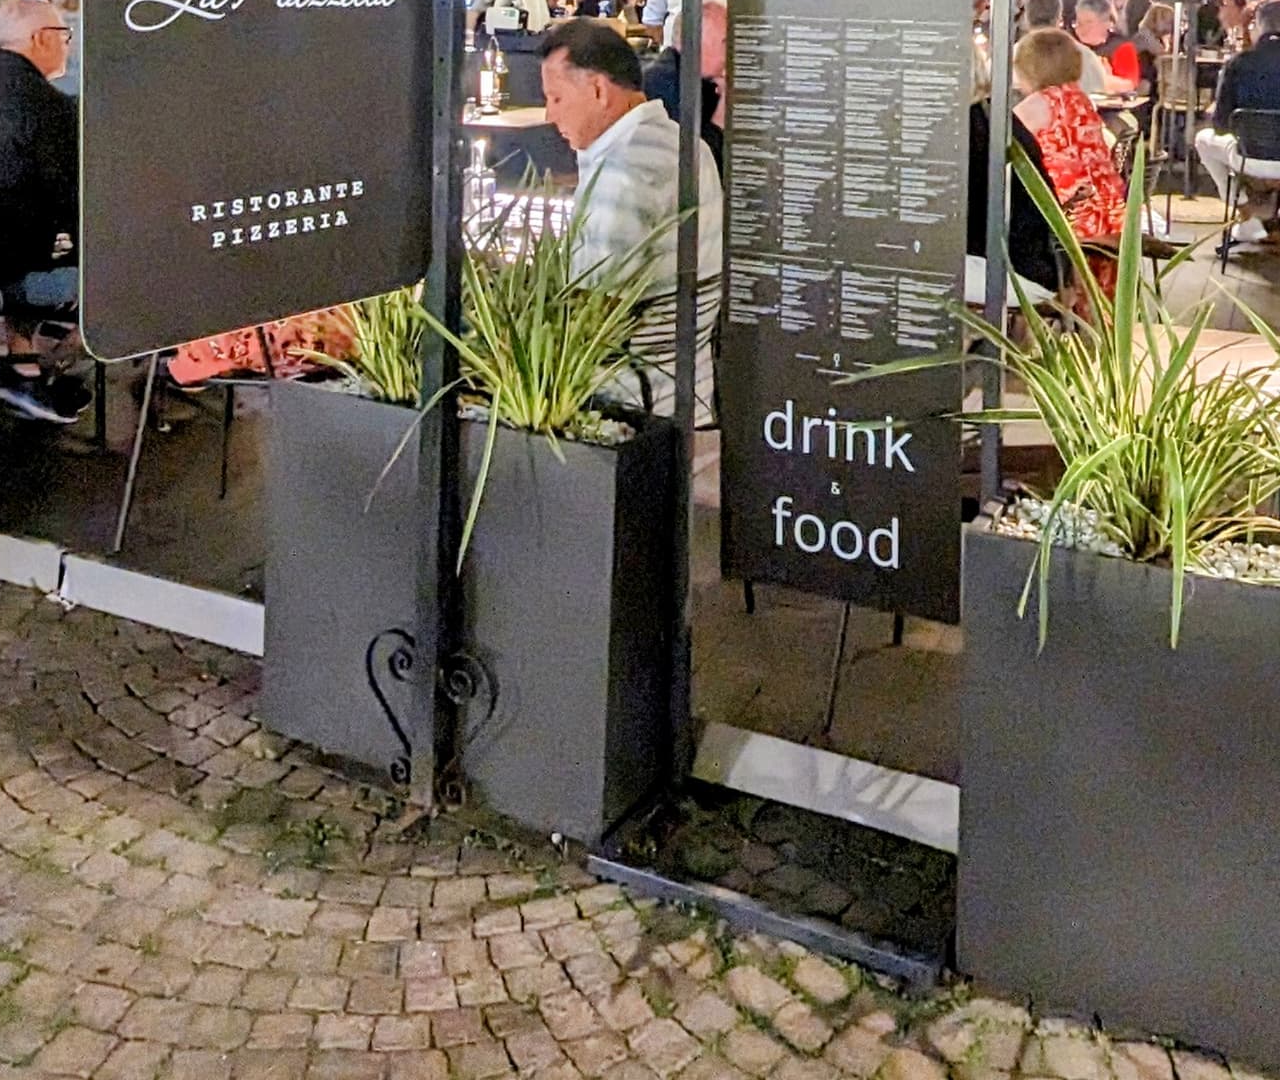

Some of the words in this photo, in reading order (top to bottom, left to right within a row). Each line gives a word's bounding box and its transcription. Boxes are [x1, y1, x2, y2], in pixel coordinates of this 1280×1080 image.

[191, 181, 365, 222] RISTORANTE
[211, 211, 349, 248] PIZZERIA
[763, 399, 915, 473] drink
[830, 481, 841, 496] &
[771, 496, 901, 570] food
